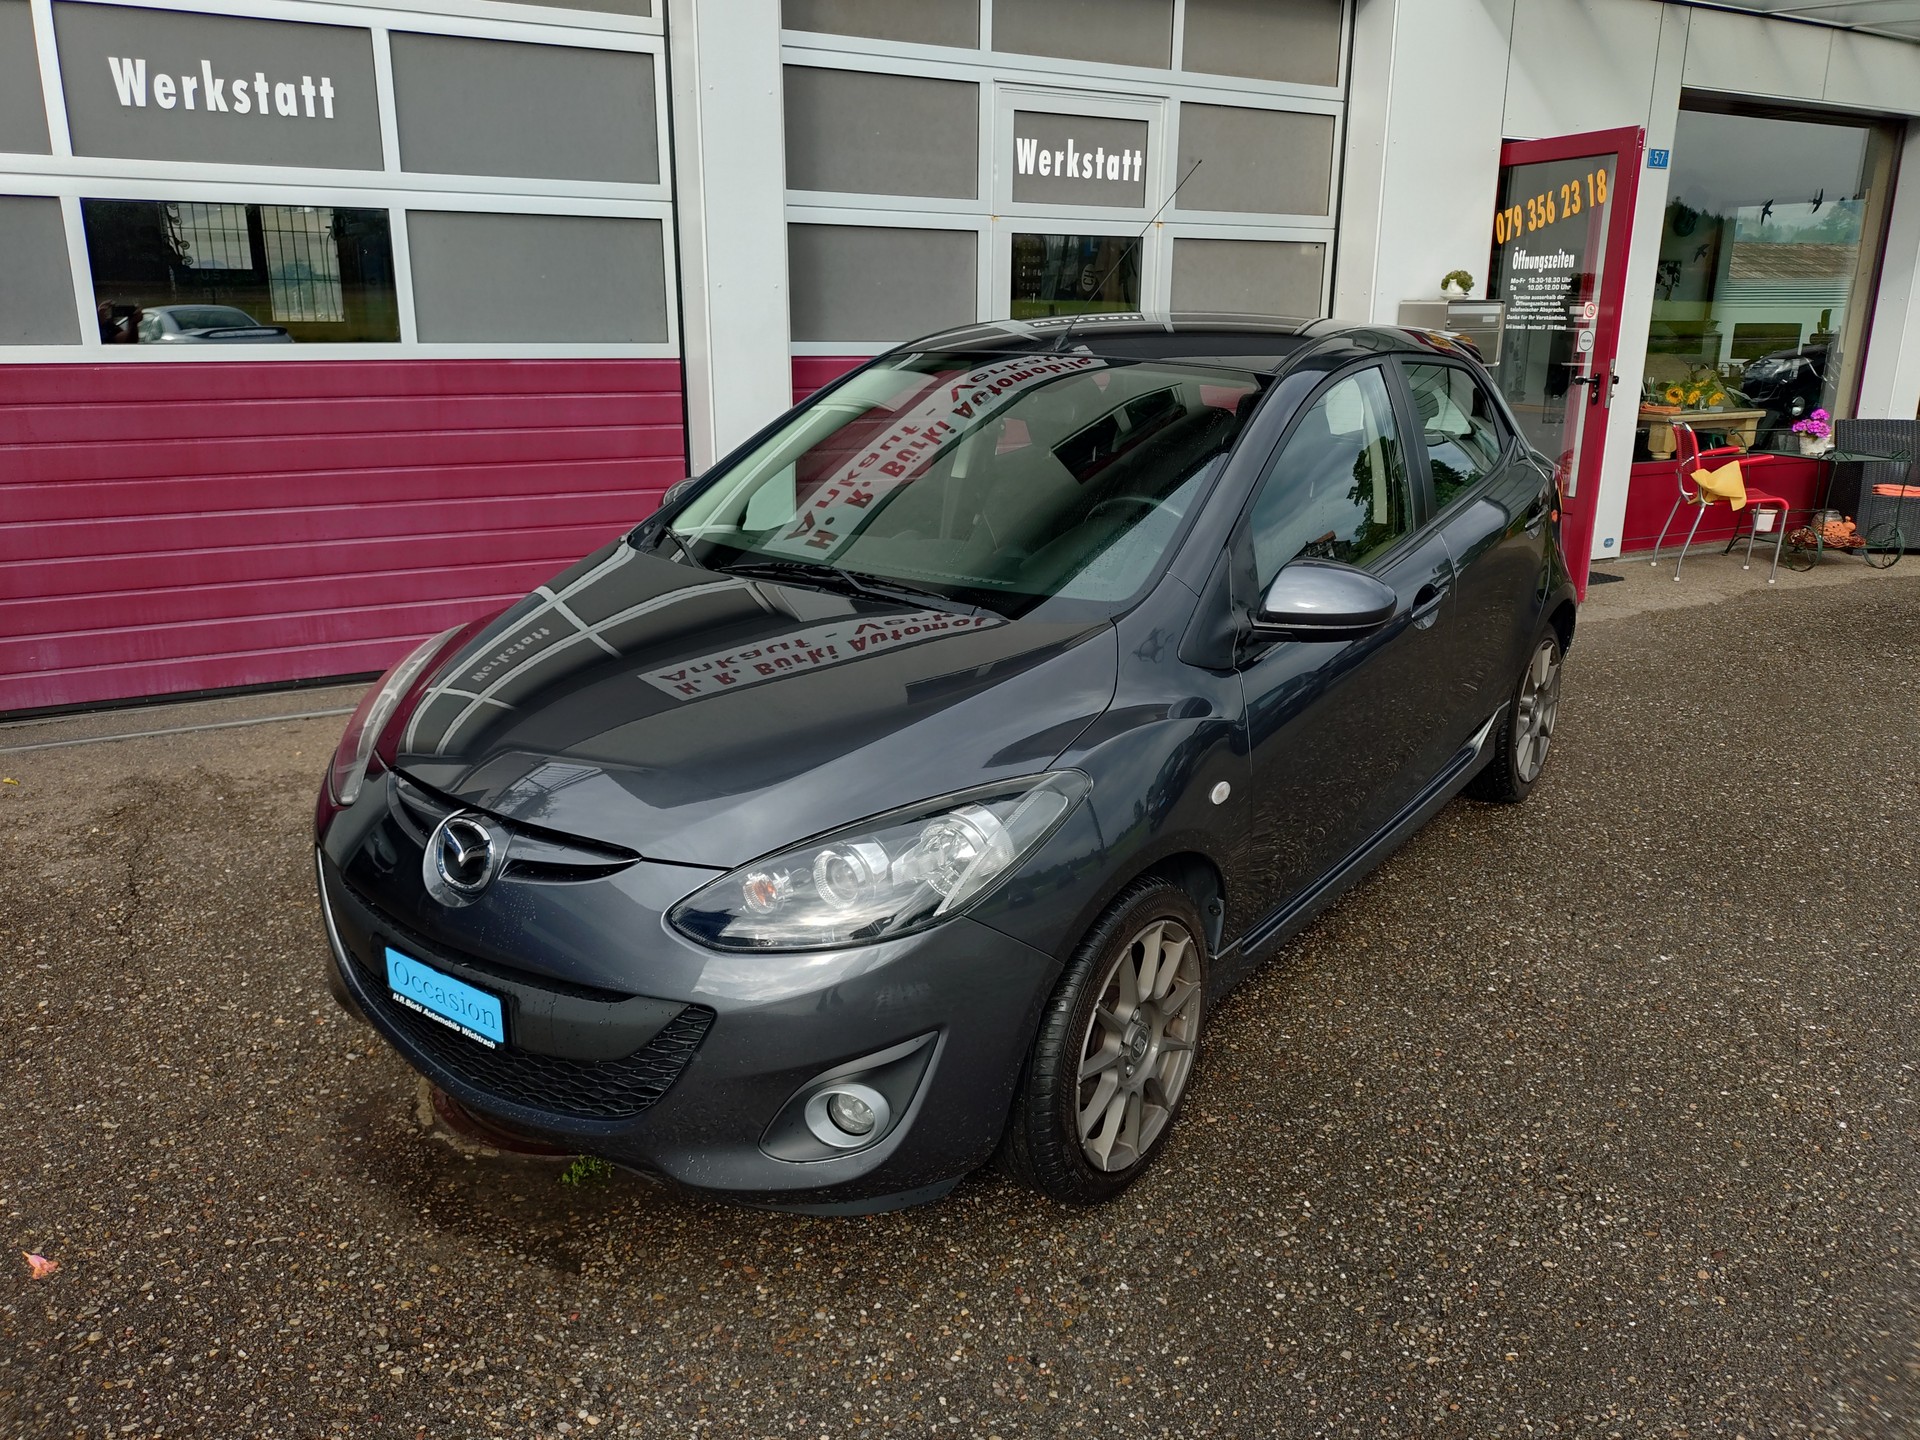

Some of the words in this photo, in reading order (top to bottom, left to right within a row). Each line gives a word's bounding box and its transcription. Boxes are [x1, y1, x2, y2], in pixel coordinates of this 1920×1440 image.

[107, 56, 335, 119] Werkstatt
[1016, 137, 1142, 182] Werkstatt
[1653, 151, 1665, 165] 57
[1496, 204, 1523, 245] 079
[1527, 190, 1556, 232] 356
[1561, 179, 1581, 219] 23
[1587, 168, 1607, 208] 18
[1082, 269, 1094, 286] CH
[1512, 246, 1575, 273] Öffnungszeiten
[393, 961, 497, 1030] Occasion
[422, 1008, 461, 1032] Automobile
[461, 1026, 496, 1050] Wichtrach
